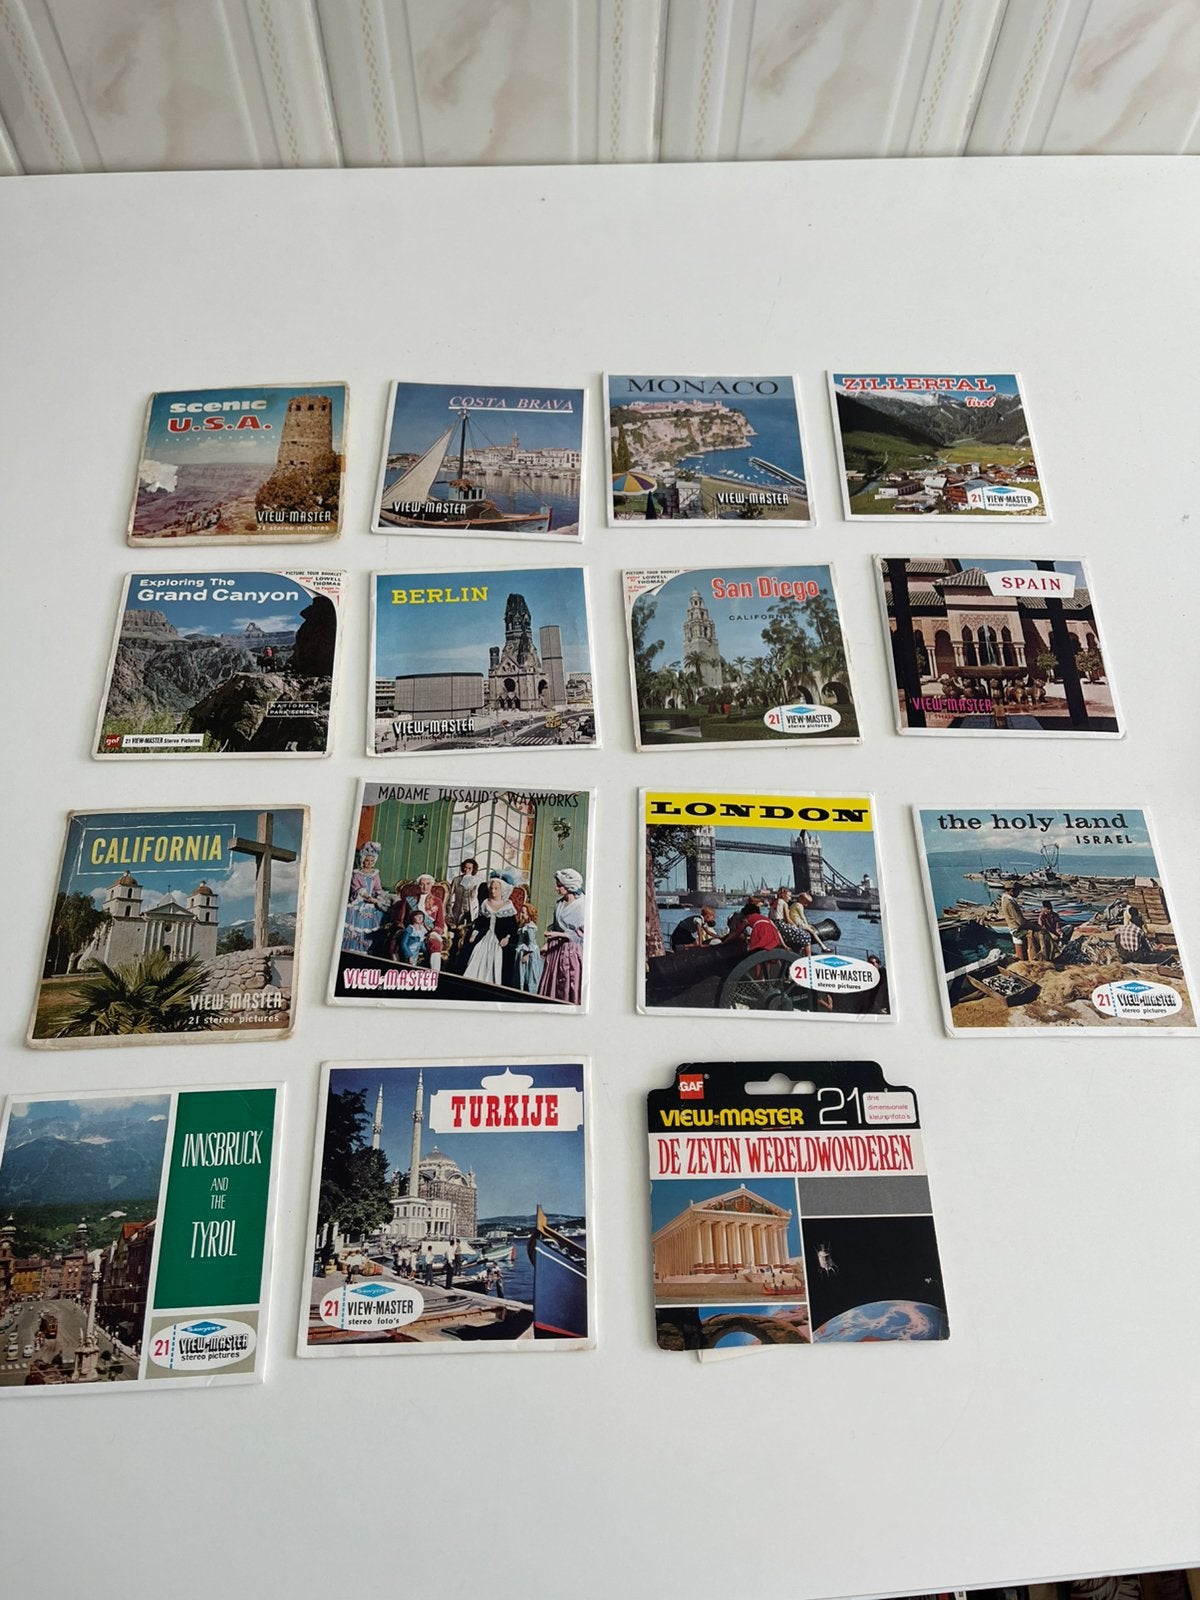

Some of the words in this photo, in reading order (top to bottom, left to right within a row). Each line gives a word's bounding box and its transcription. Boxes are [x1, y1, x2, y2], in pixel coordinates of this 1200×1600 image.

[627, 378, 779, 396] MONACO
[842, 377, 996, 392] ZILLERTAL
[169, 400, 267, 413] scenic
[449, 396, 507, 408] COSTA
[517, 398, 573, 410] BRAVA
[966, 396, 997, 408] Tirol
[168, 415, 273, 433] U.S.A.
[717, 492, 789, 505] VIEW-MASTER
[971, 493, 982, 503] 21
[986, 494, 1032, 504] VIEW-MASTER
[394, 501, 467, 514] VIEW-MASTER
[257, 510, 331, 522] VIEW-MASTER
[139, 577, 205, 588] Exploring
[210, 577, 236, 586] The
[711, 577, 756, 600] San
[757, 576, 820, 602] Diego
[1001, 576, 1062, 591] SPAIN
[137, 589, 207, 602] Grand
[212, 589, 299, 604] Canyon
[392, 587, 488, 604] BERLIN
[911, 697, 992, 712] VIEW-MASTER
[768, 713, 780, 724] 21
[786, 714, 833, 724] VIEW-MASTER
[393, 719, 475, 735] VIEW-MASTER
[378, 786, 430, 801] MADAME
[438, 788, 500, 805] TUSSAUD'S
[507, 793, 579, 808] WAXWORKS
[651, 801, 868, 823] LONDON
[938, 814, 982, 830] the
[991, 814, 1055, 833] holy
[1064, 813, 1129, 829] land
[1076, 835, 1133, 844] ISRAEL
[91, 835, 222, 865] CALIFORNIA
[343, 968, 439, 991] VIEW-MASTER
[794, 966, 807, 979] 21
[815, 968, 873, 983] VIEW-MASTER
[190, 992, 282, 1010] VIEW-MASTER
[1097, 993, 1111, 1007] 21
[1117, 993, 1177, 1007] VIEW-MASTER
[188, 1016, 200, 1024] 21
[203, 1015, 235, 1024] stereo
[239, 1014, 279, 1024] pictures
[680, 1081, 703, 1092] GAF
[451, 1095, 559, 1128] TURKIJE
[817, 1087, 862, 1124] 21
[660, 1108, 804, 1127] VIEW-MASTER
[181, 1130, 264, 1167] INNSBRUCK
[657, 1138, 682, 1175] DE
[686, 1137, 742, 1175] ZEVEN
[745, 1134, 914, 1174] WERELDWONDEREN
[210, 1177, 229, 1191] AND
[210, 1194, 226, 1210] THE
[190, 1219, 237, 1259] TYROL
[324, 1300, 339, 1316] 21
[347, 1300, 414, 1316] VIEW-MASTER
[377, 1317, 400, 1325] foto's
[154, 1339, 170, 1356] 21
[179, 1333, 249, 1355] VIEW-MASTER
[208, 1352, 240, 1361] pictures
